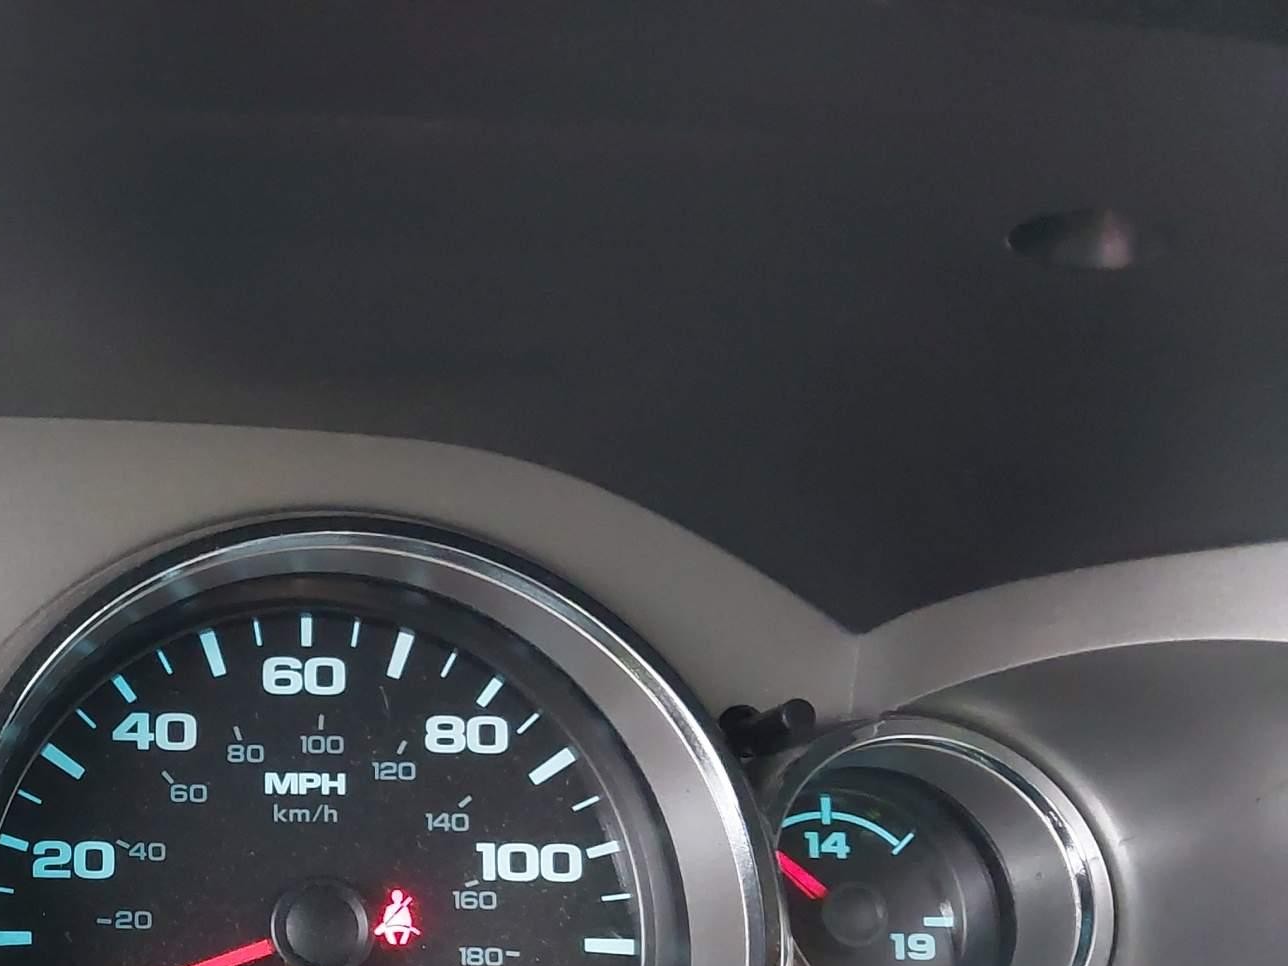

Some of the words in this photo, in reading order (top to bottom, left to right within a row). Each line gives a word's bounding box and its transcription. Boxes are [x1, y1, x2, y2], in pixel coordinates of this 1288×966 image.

[262, 656, 346, 696] 60
[112, 712, 197, 751] 40
[425, 715, 508, 754] 80
[227, 744, 264, 764] 80
[300, 734, 344, 755] 100
[373, 761, 416, 781] 120
[170, 783, 207, 803] 60
[264, 772, 346, 795] MPH
[273, 803, 338, 825] km/h
[426, 812, 469, 833] 140
[128, 842, 166, 862] 40
[804, 831, 851, 859] 14
[32, 841, 115, 879] 20
[475, 843, 582, 881] 100
[453, 889, 497, 911] 160
[114, 910, 152, 930] 20
[458, 947, 503, 966] 180
[889, 933, 936, 961] 19
